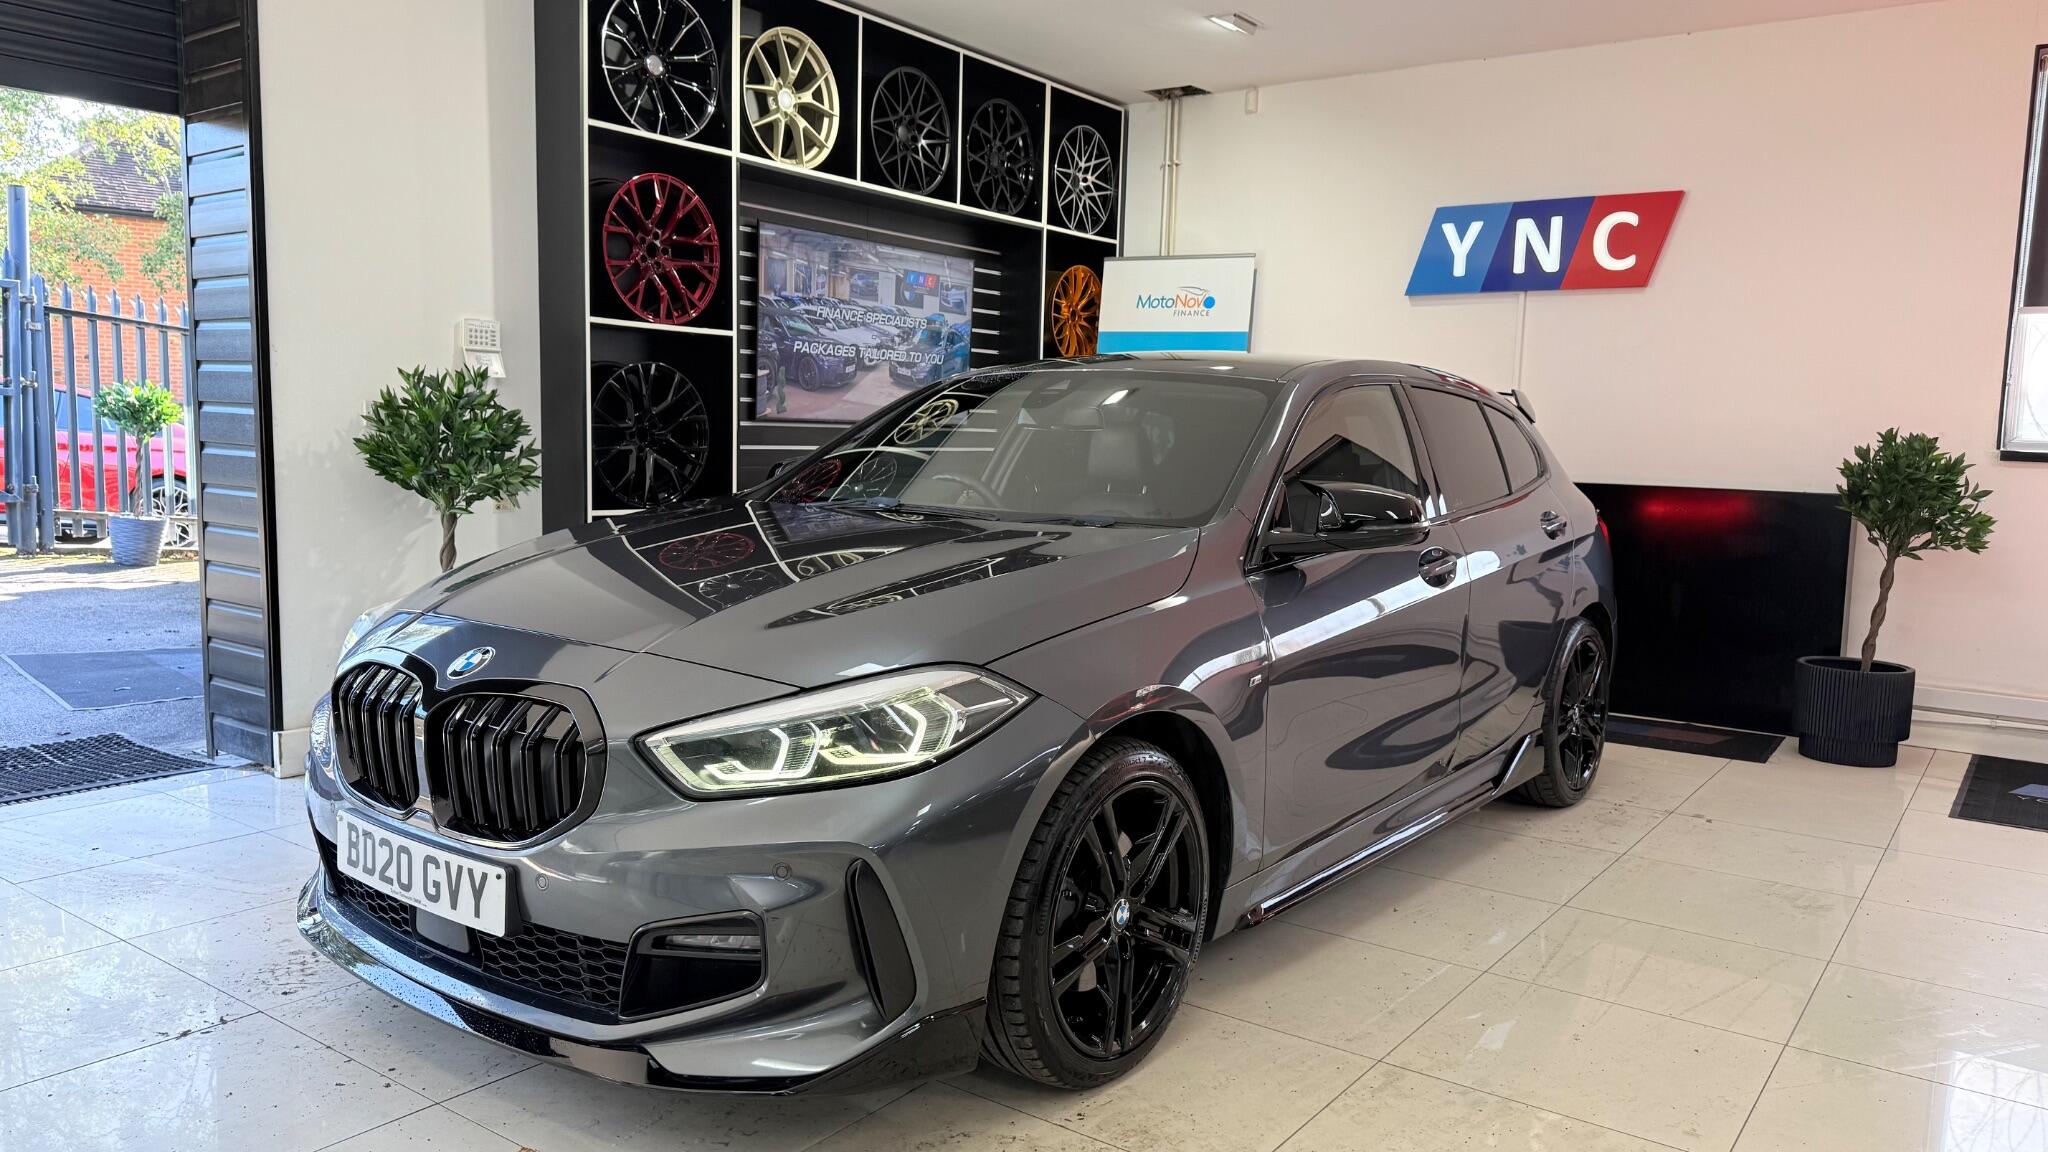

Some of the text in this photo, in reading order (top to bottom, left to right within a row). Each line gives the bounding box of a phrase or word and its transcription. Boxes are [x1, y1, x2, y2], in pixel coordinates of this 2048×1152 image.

[1441, 211, 1639, 277] YNC
[816, 306, 927, 329] FINANCE SPECIALISTS
[1173, 309, 1210, 317] FINANCE
[793, 341, 945, 365] PACKAGES TAILORED TO YOU
[346, 821, 488, 919] BD20 GVY
